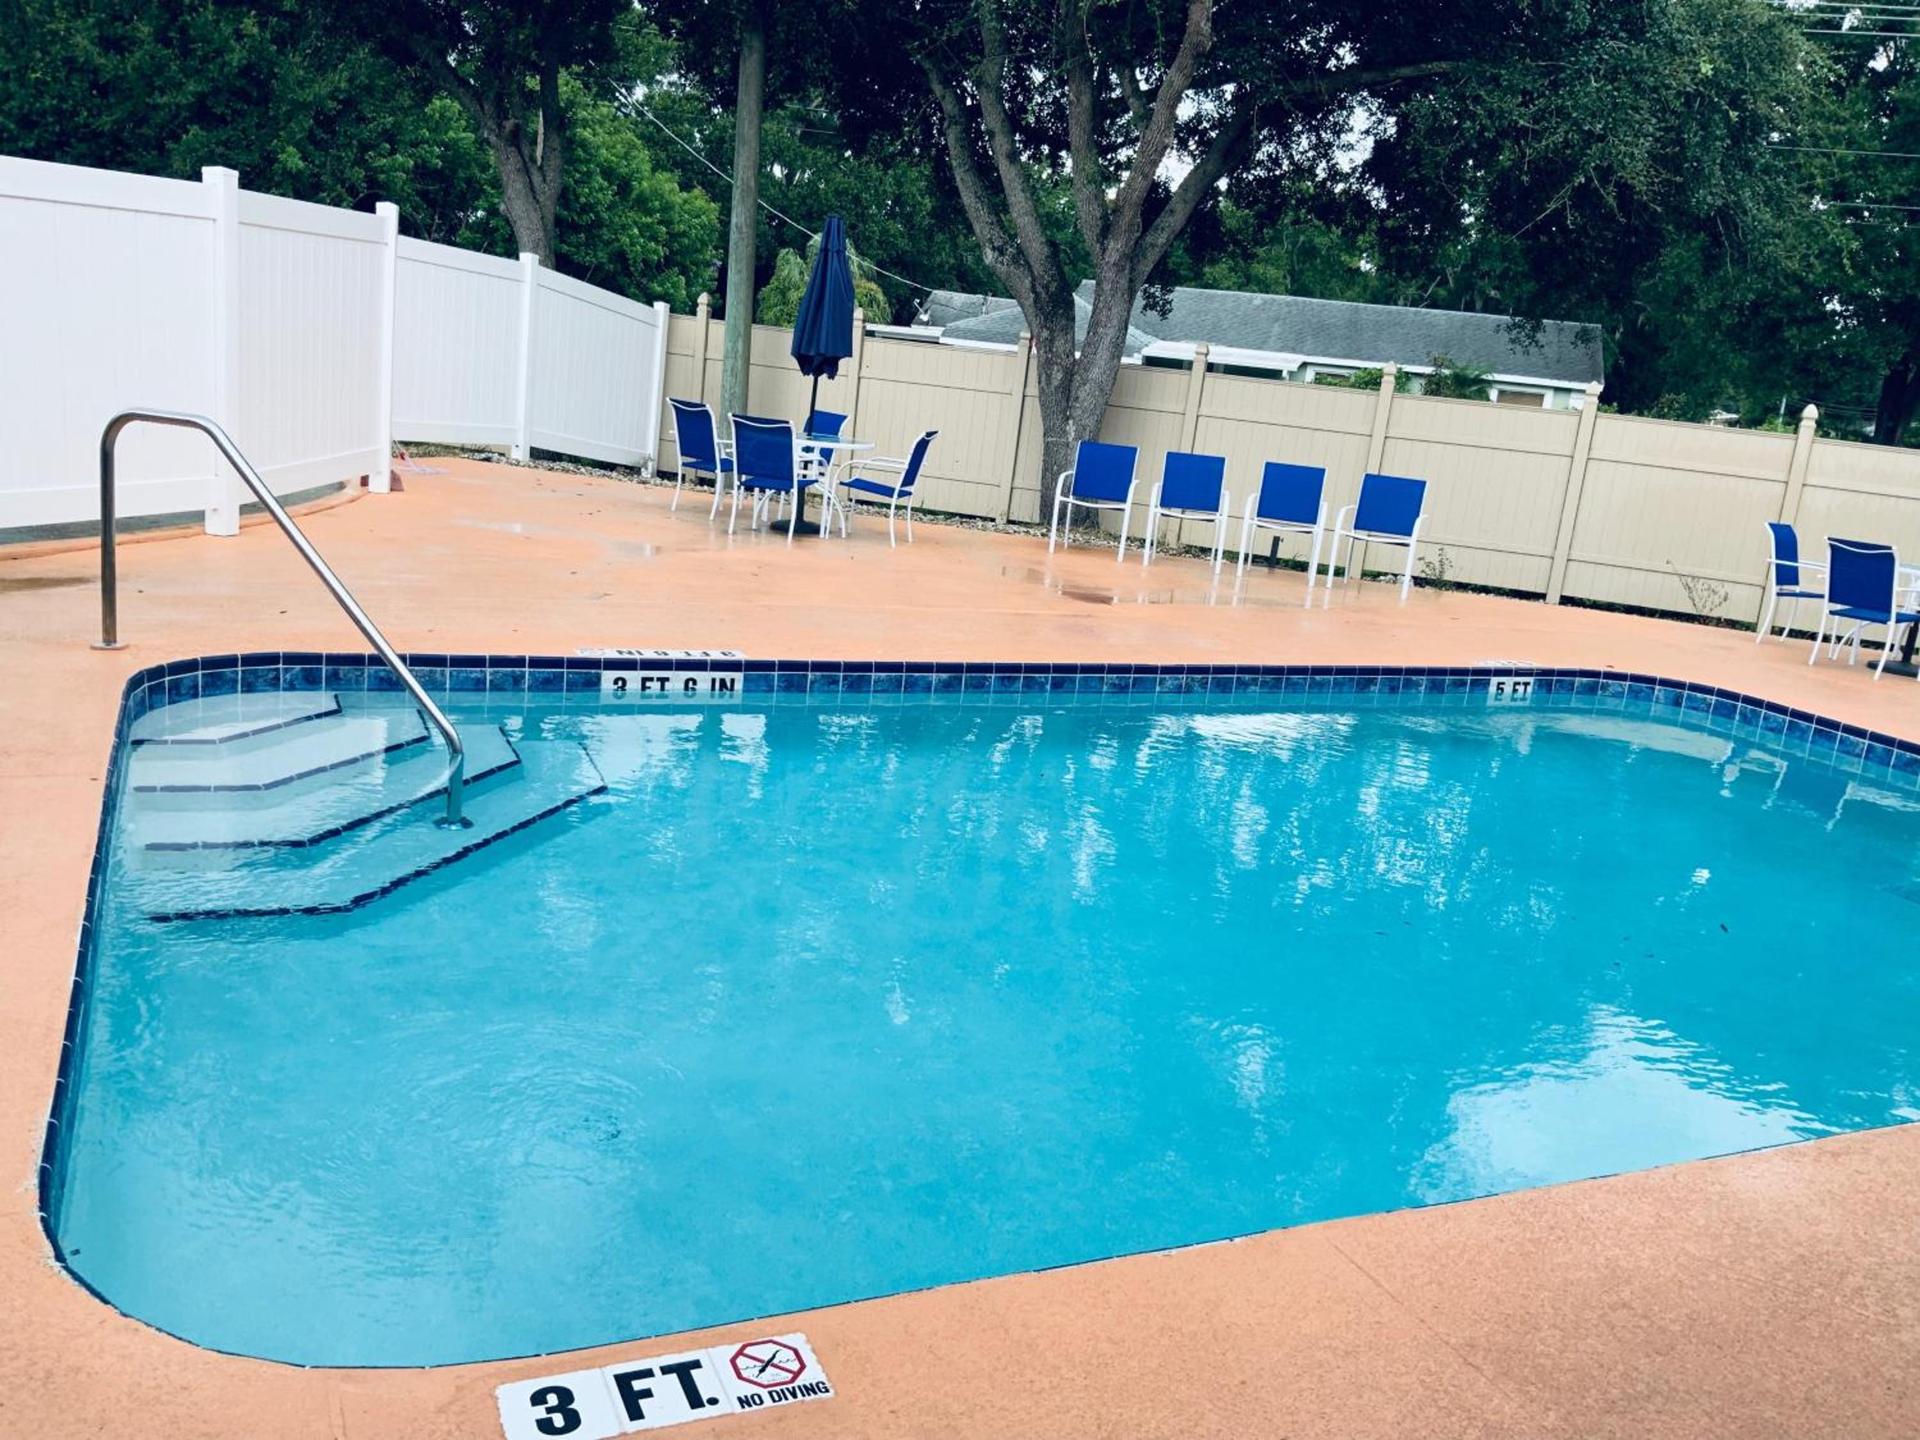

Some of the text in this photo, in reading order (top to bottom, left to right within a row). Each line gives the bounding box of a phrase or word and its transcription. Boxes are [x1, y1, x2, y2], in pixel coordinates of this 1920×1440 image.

[612, 676, 736, 694] 3 FT 6 IN
[1495, 681, 1531, 696] 5 FT
[529, 1358, 720, 1436] 3 FT.
[736, 1380, 831, 1409] NO DIVING
